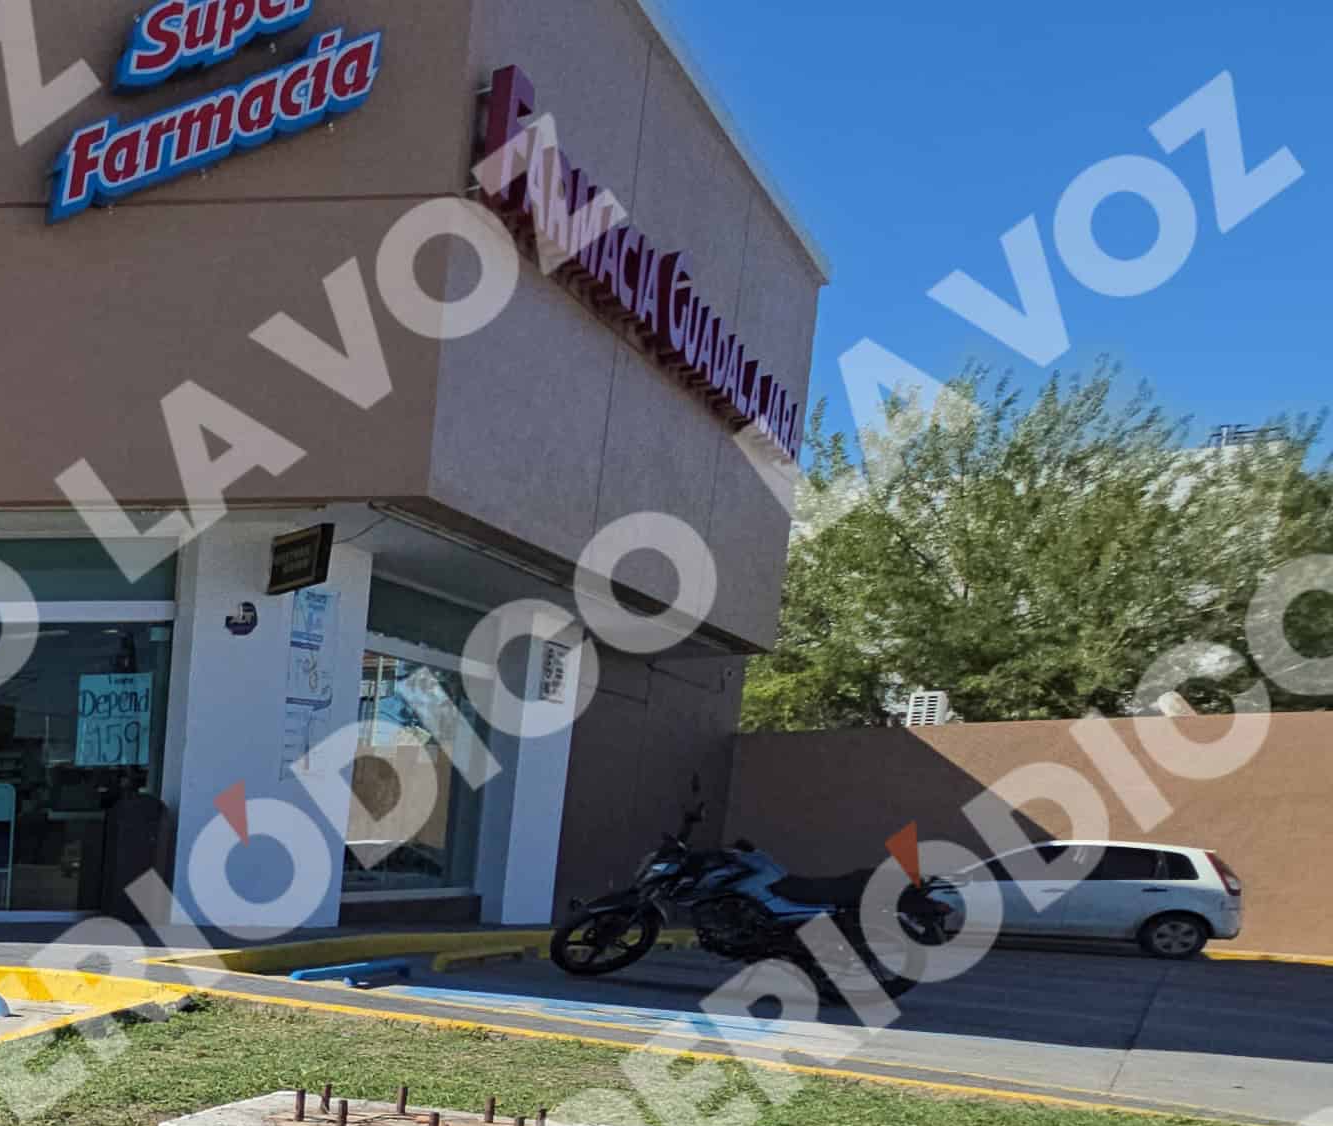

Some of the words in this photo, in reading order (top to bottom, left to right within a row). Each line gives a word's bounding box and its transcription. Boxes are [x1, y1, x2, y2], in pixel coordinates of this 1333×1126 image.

[61, 27, 381, 206] Farmacia
[665, 249, 803, 458] GUADALAJARA
[80, 688, 151, 718] Depend
